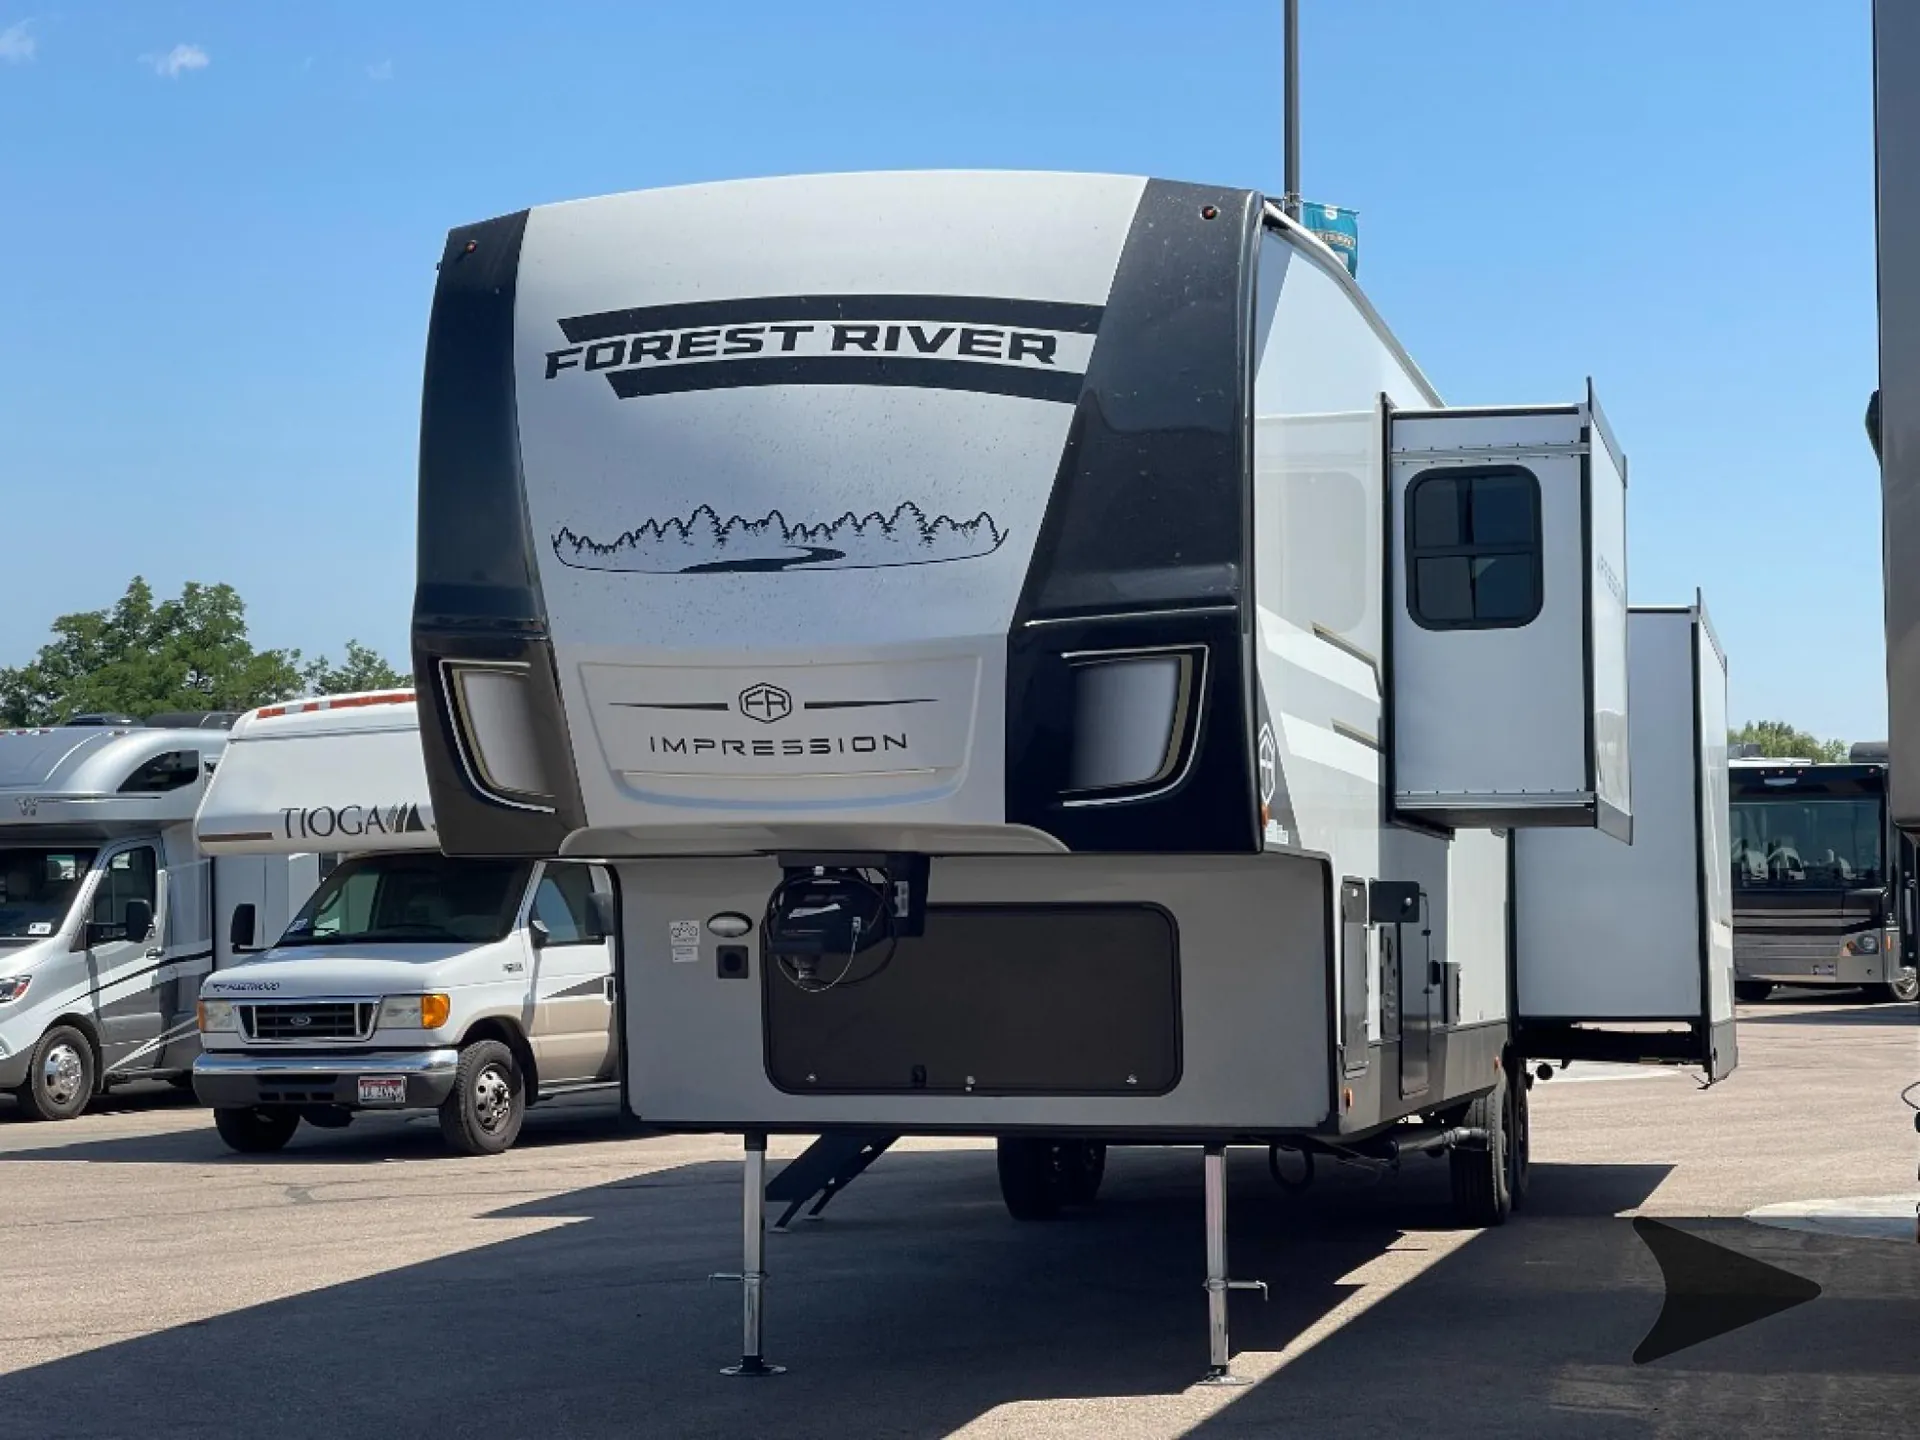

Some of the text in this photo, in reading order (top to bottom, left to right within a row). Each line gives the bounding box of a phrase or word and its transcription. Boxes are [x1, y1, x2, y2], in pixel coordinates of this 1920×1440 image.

[545, 325, 1057, 379] FOREST RIVER
[745, 689, 787, 717] FR
[650, 733, 908, 756] IMPRESSION
[279, 804, 387, 838] TIOGA
